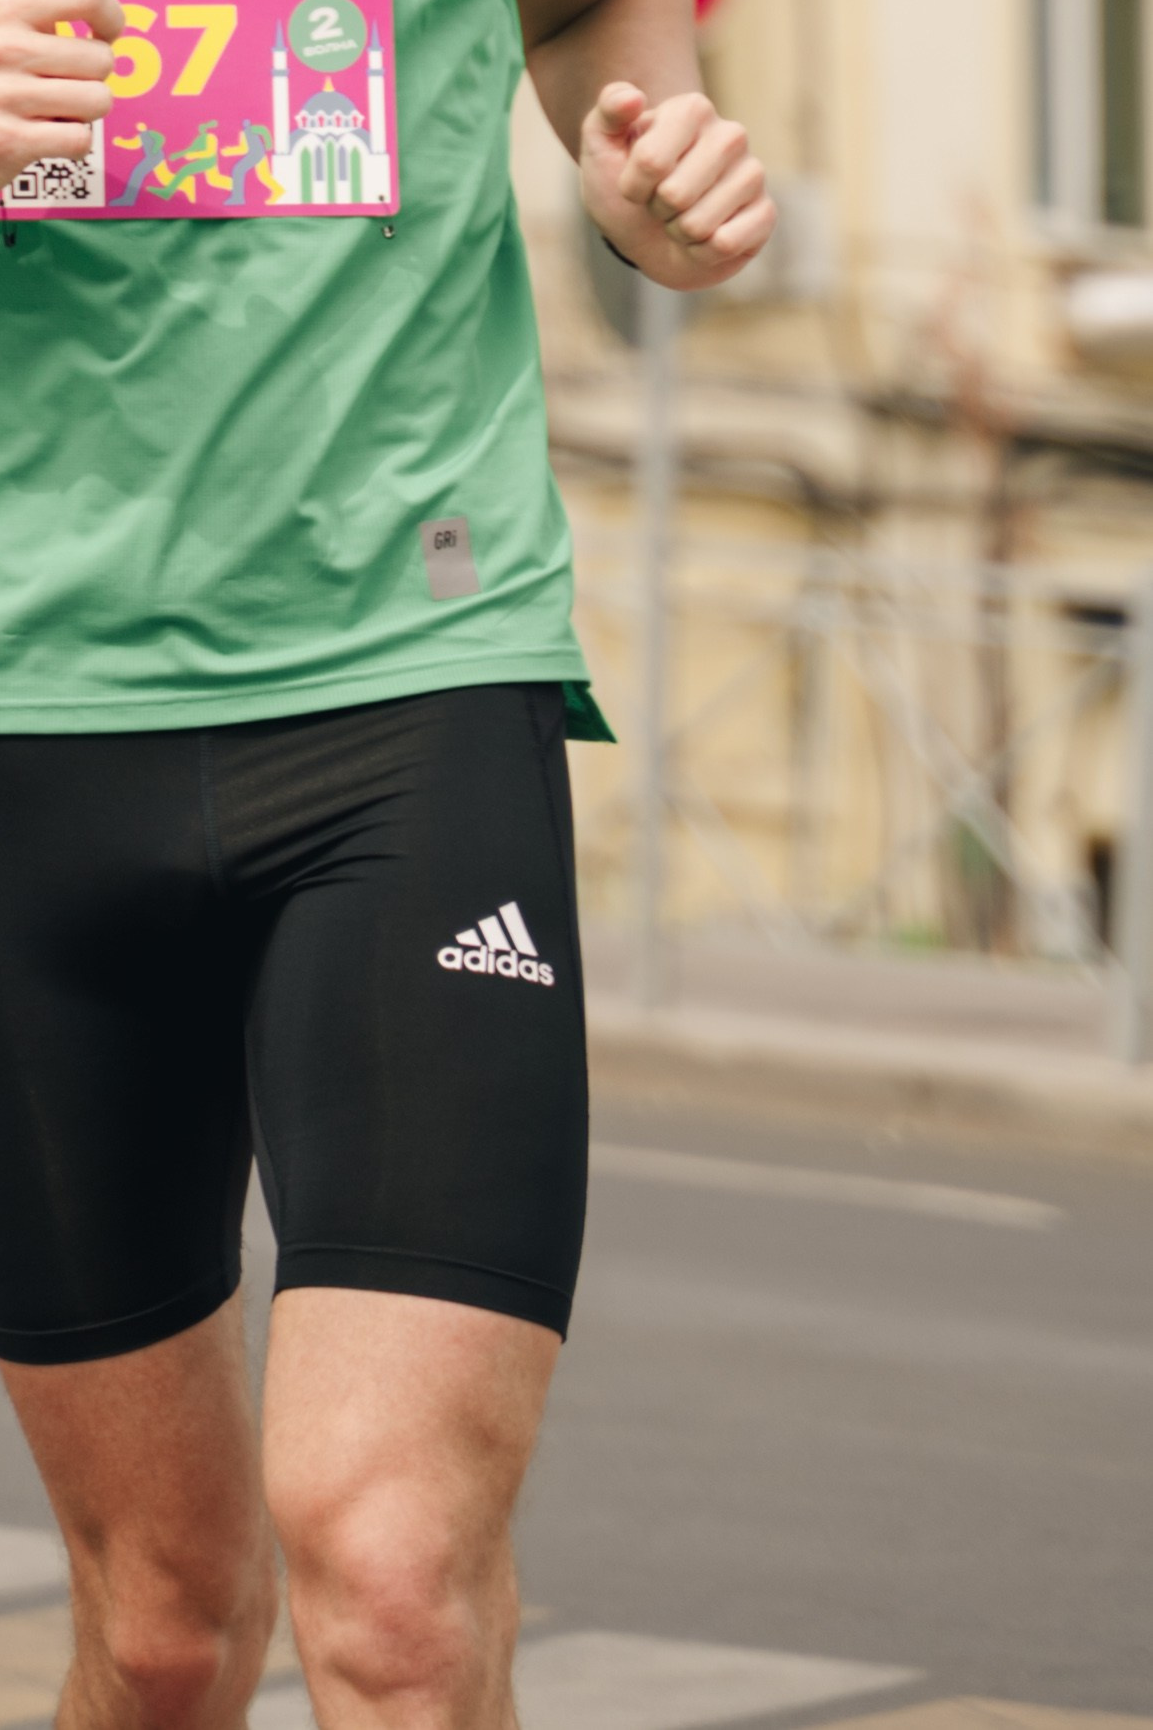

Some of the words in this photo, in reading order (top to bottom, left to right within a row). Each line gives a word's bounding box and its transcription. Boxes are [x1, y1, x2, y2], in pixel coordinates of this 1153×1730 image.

[307, 5, 344, 42] 2
[54, 3, 238, 99] 67
[437, 944, 555, 987] adidas
